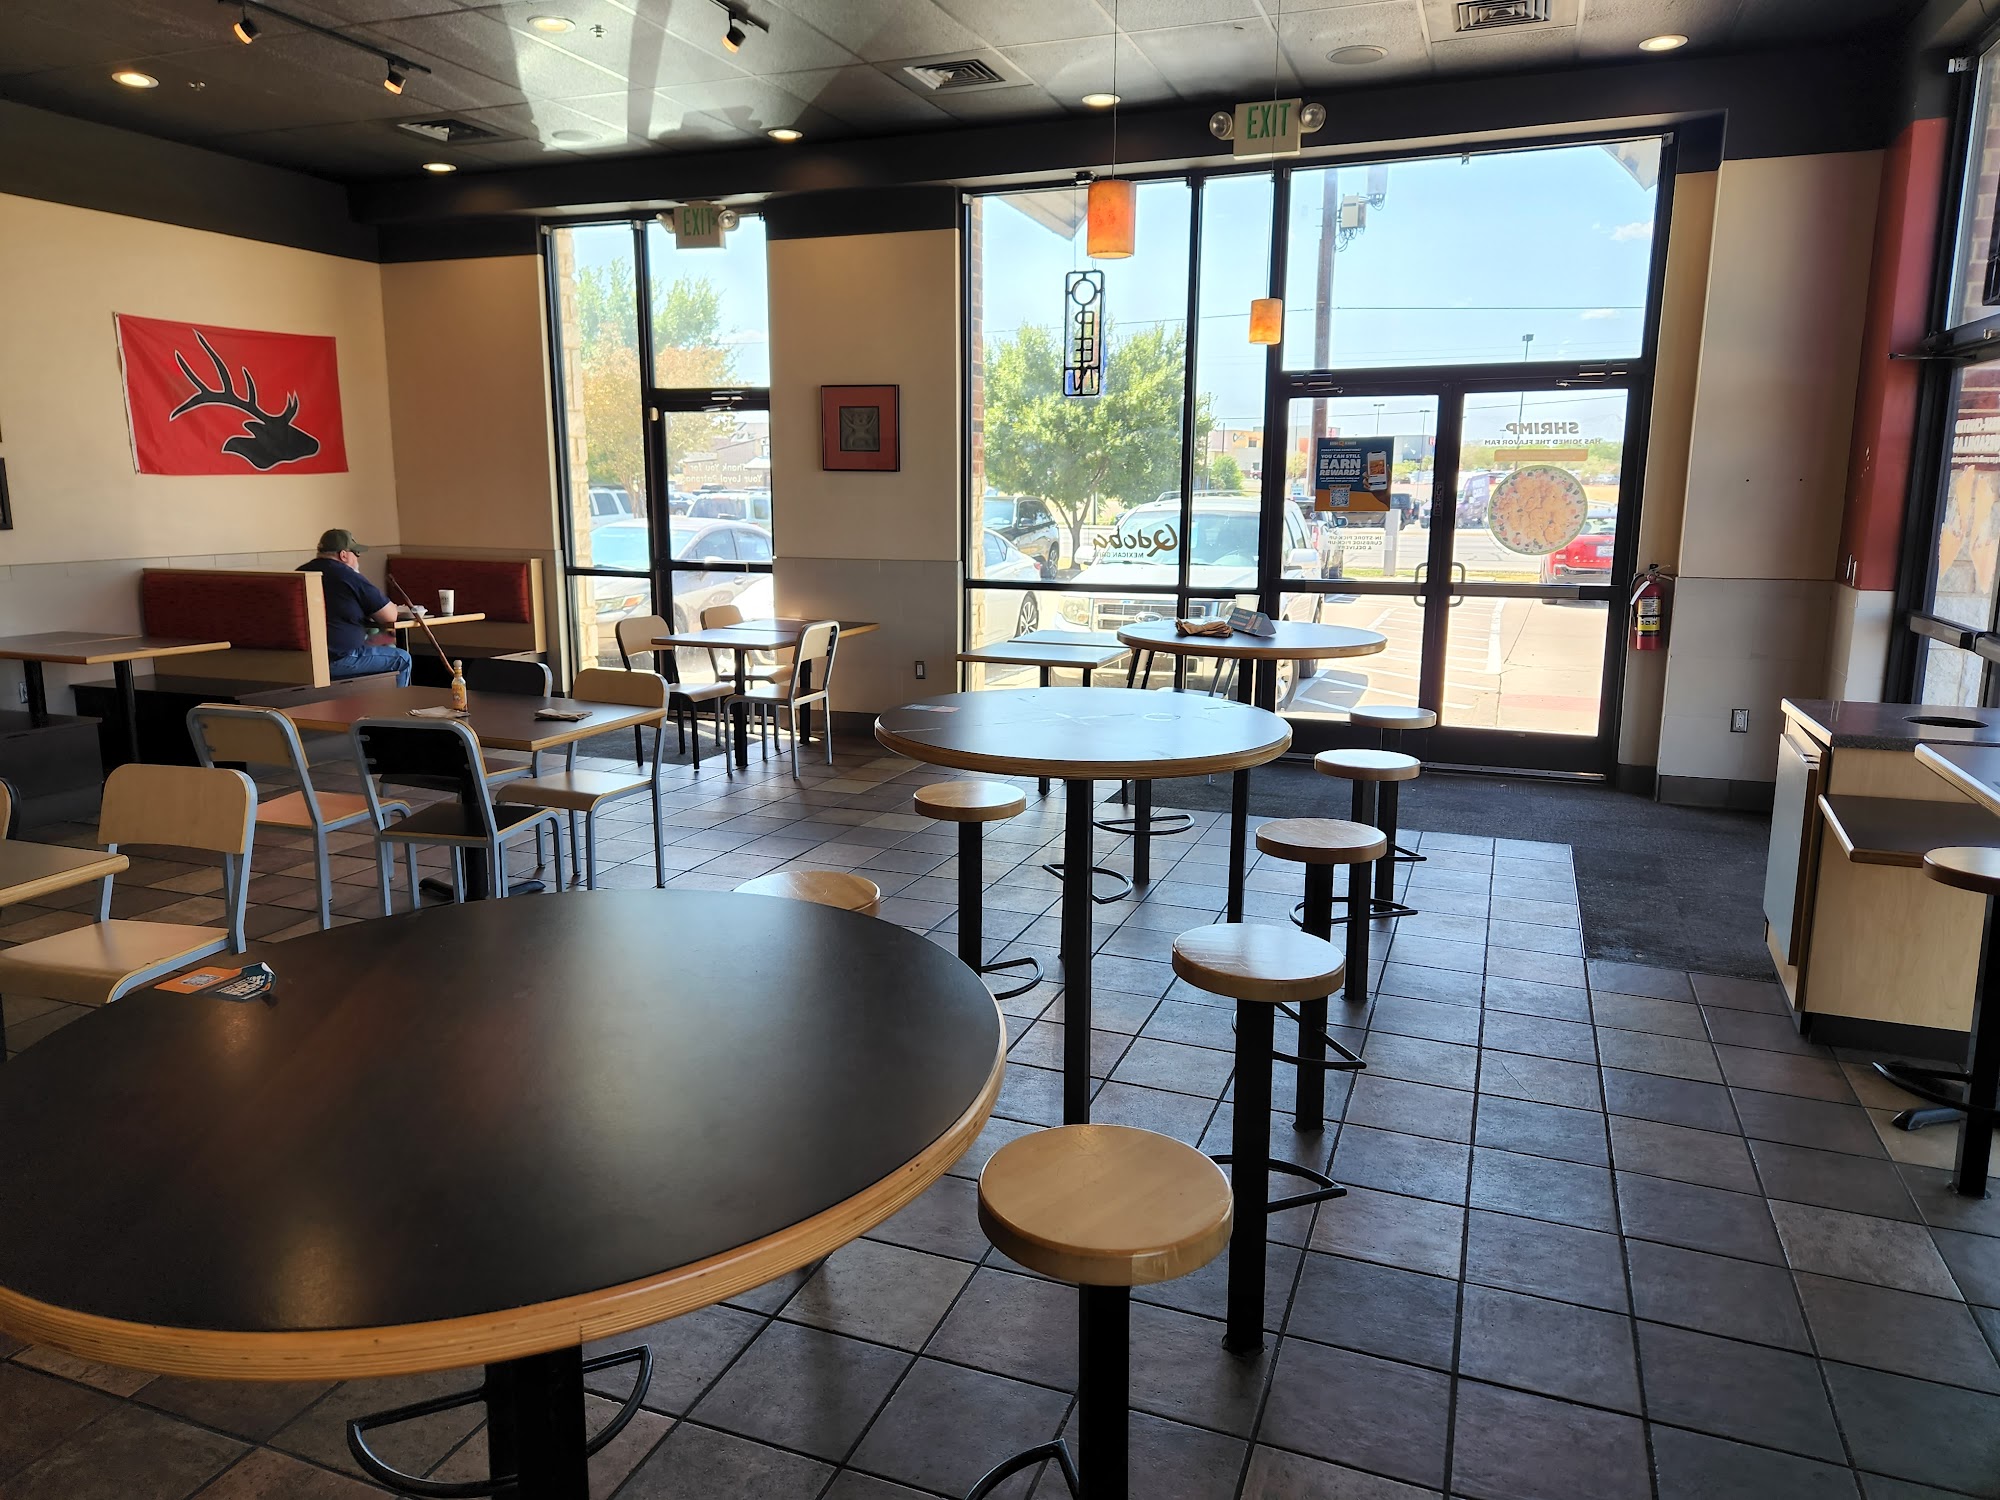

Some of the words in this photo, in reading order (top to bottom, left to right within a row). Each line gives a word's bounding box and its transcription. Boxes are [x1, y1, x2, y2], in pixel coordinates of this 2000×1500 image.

[1247, 103, 1291, 139] EXIT
[683, 208, 713, 236] EXIT
[1320, 459, 1361, 469] EARN
